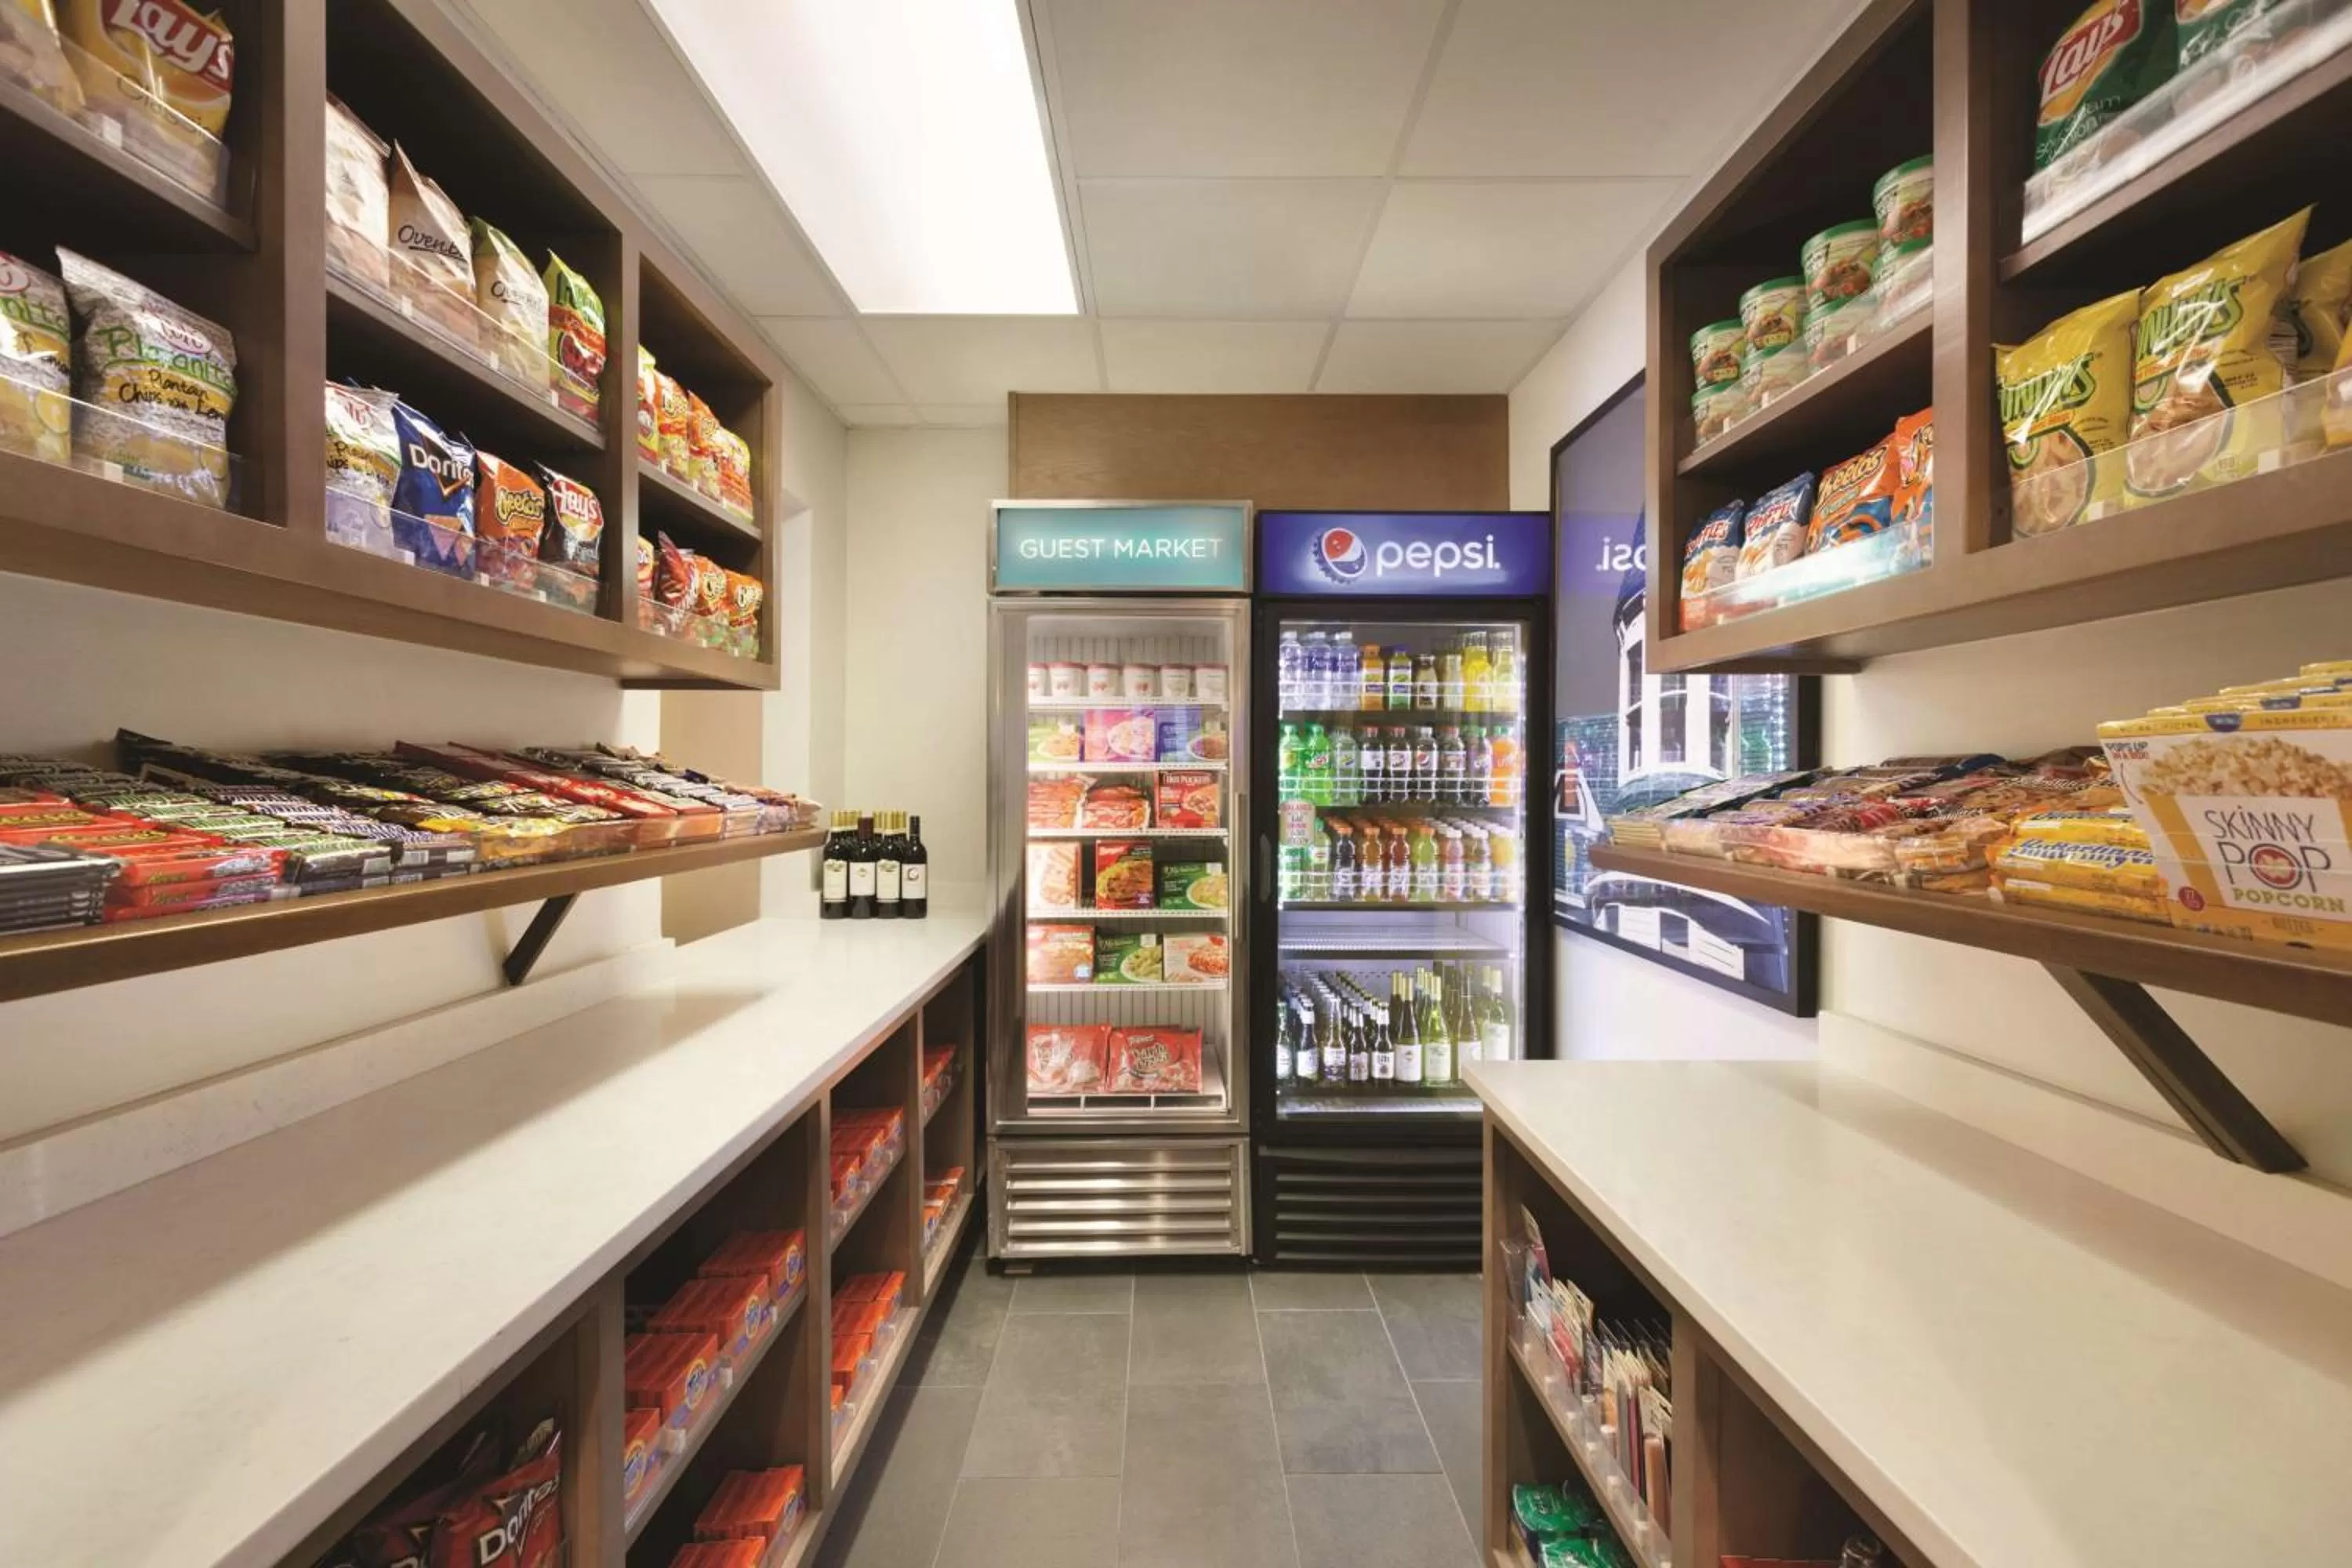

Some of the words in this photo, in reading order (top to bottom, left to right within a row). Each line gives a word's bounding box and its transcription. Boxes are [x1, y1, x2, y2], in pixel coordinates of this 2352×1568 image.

[1020, 538, 1105, 559] GUEST
[1113, 538, 1223, 559] MARKET
[2216, 841, 2332, 894] POP
[2233, 887, 2346, 913] POPCORN
